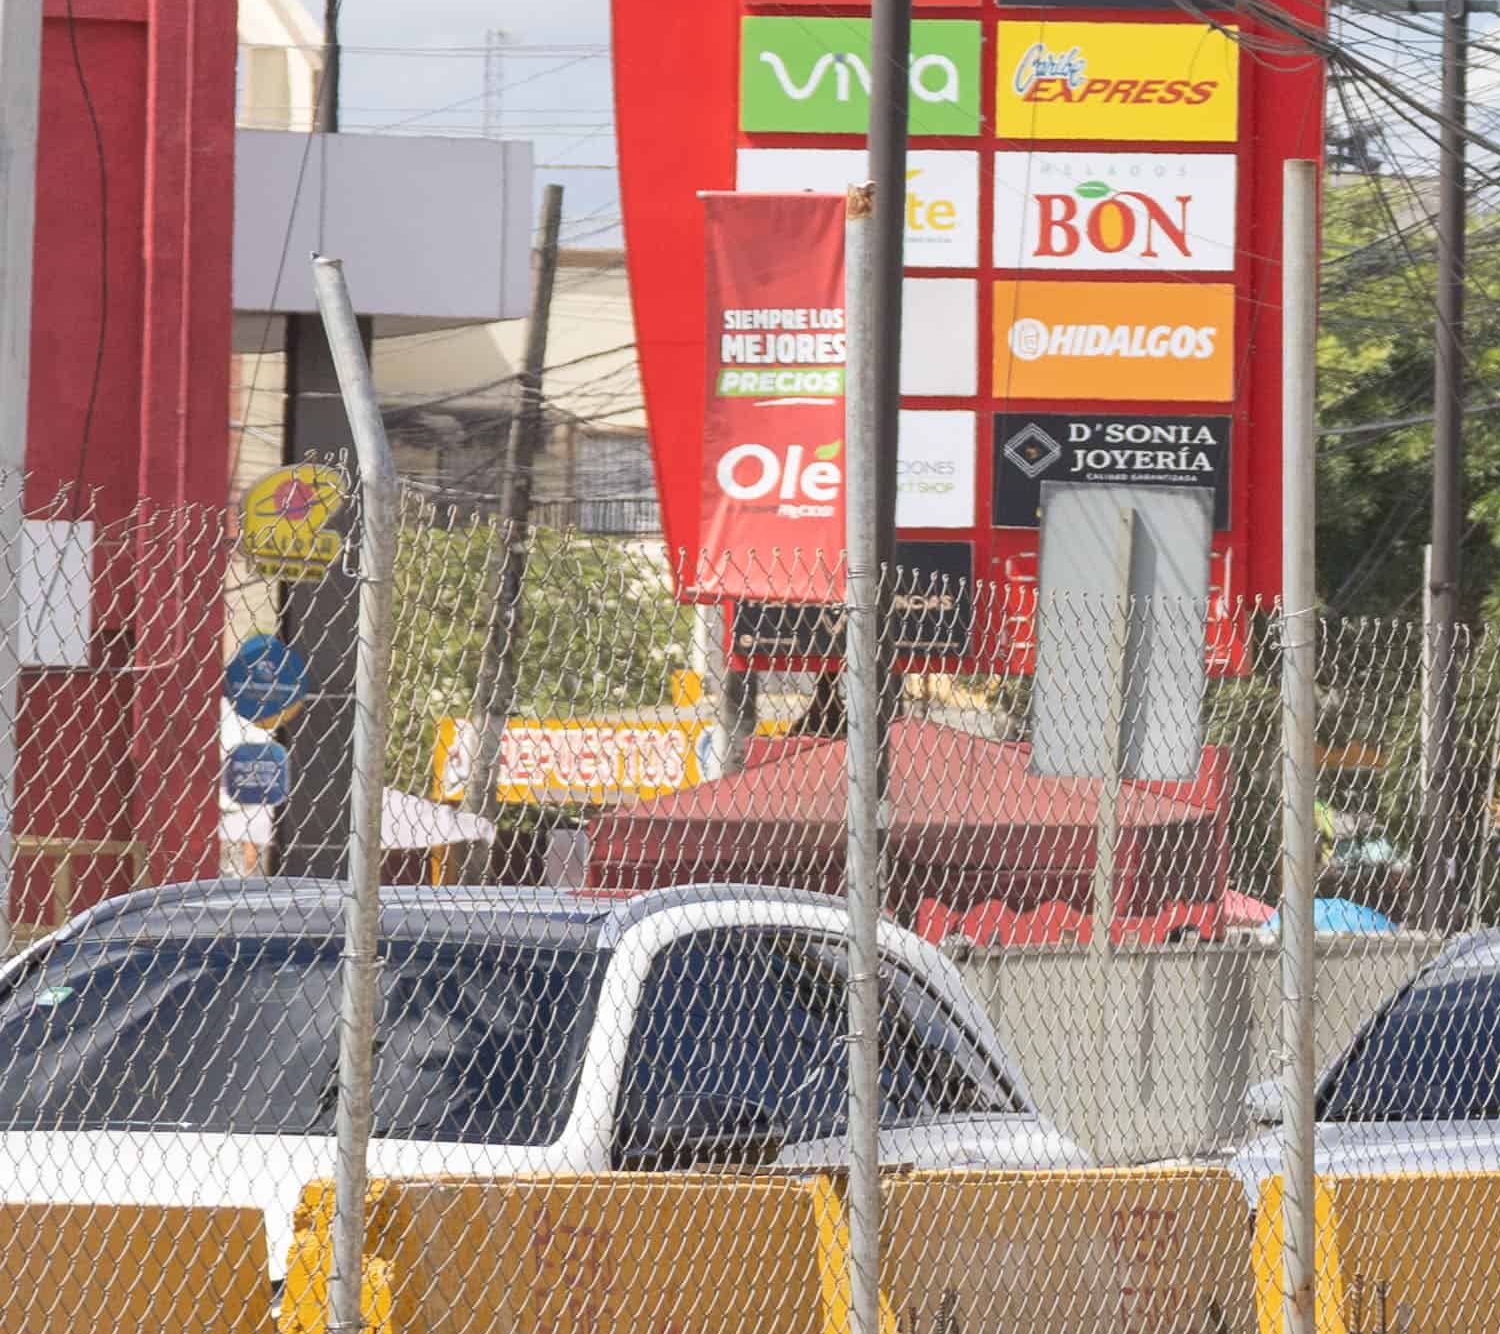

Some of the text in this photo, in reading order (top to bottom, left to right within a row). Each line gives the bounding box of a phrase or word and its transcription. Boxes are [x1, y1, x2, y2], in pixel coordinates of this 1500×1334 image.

[1023, 79, 1218, 105] EXPRESS
[1033, 191, 1192, 258] BON
[723, 308, 844, 330] SIEMPRE LOS
[721, 333, 847, 364] MEJORES
[1048, 324, 1217, 358] HIDALGOS
[720, 370, 840, 393] PRECIOS
[716, 440, 842, 501] Olé
[1070, 447, 1214, 473] JOYERÍA
